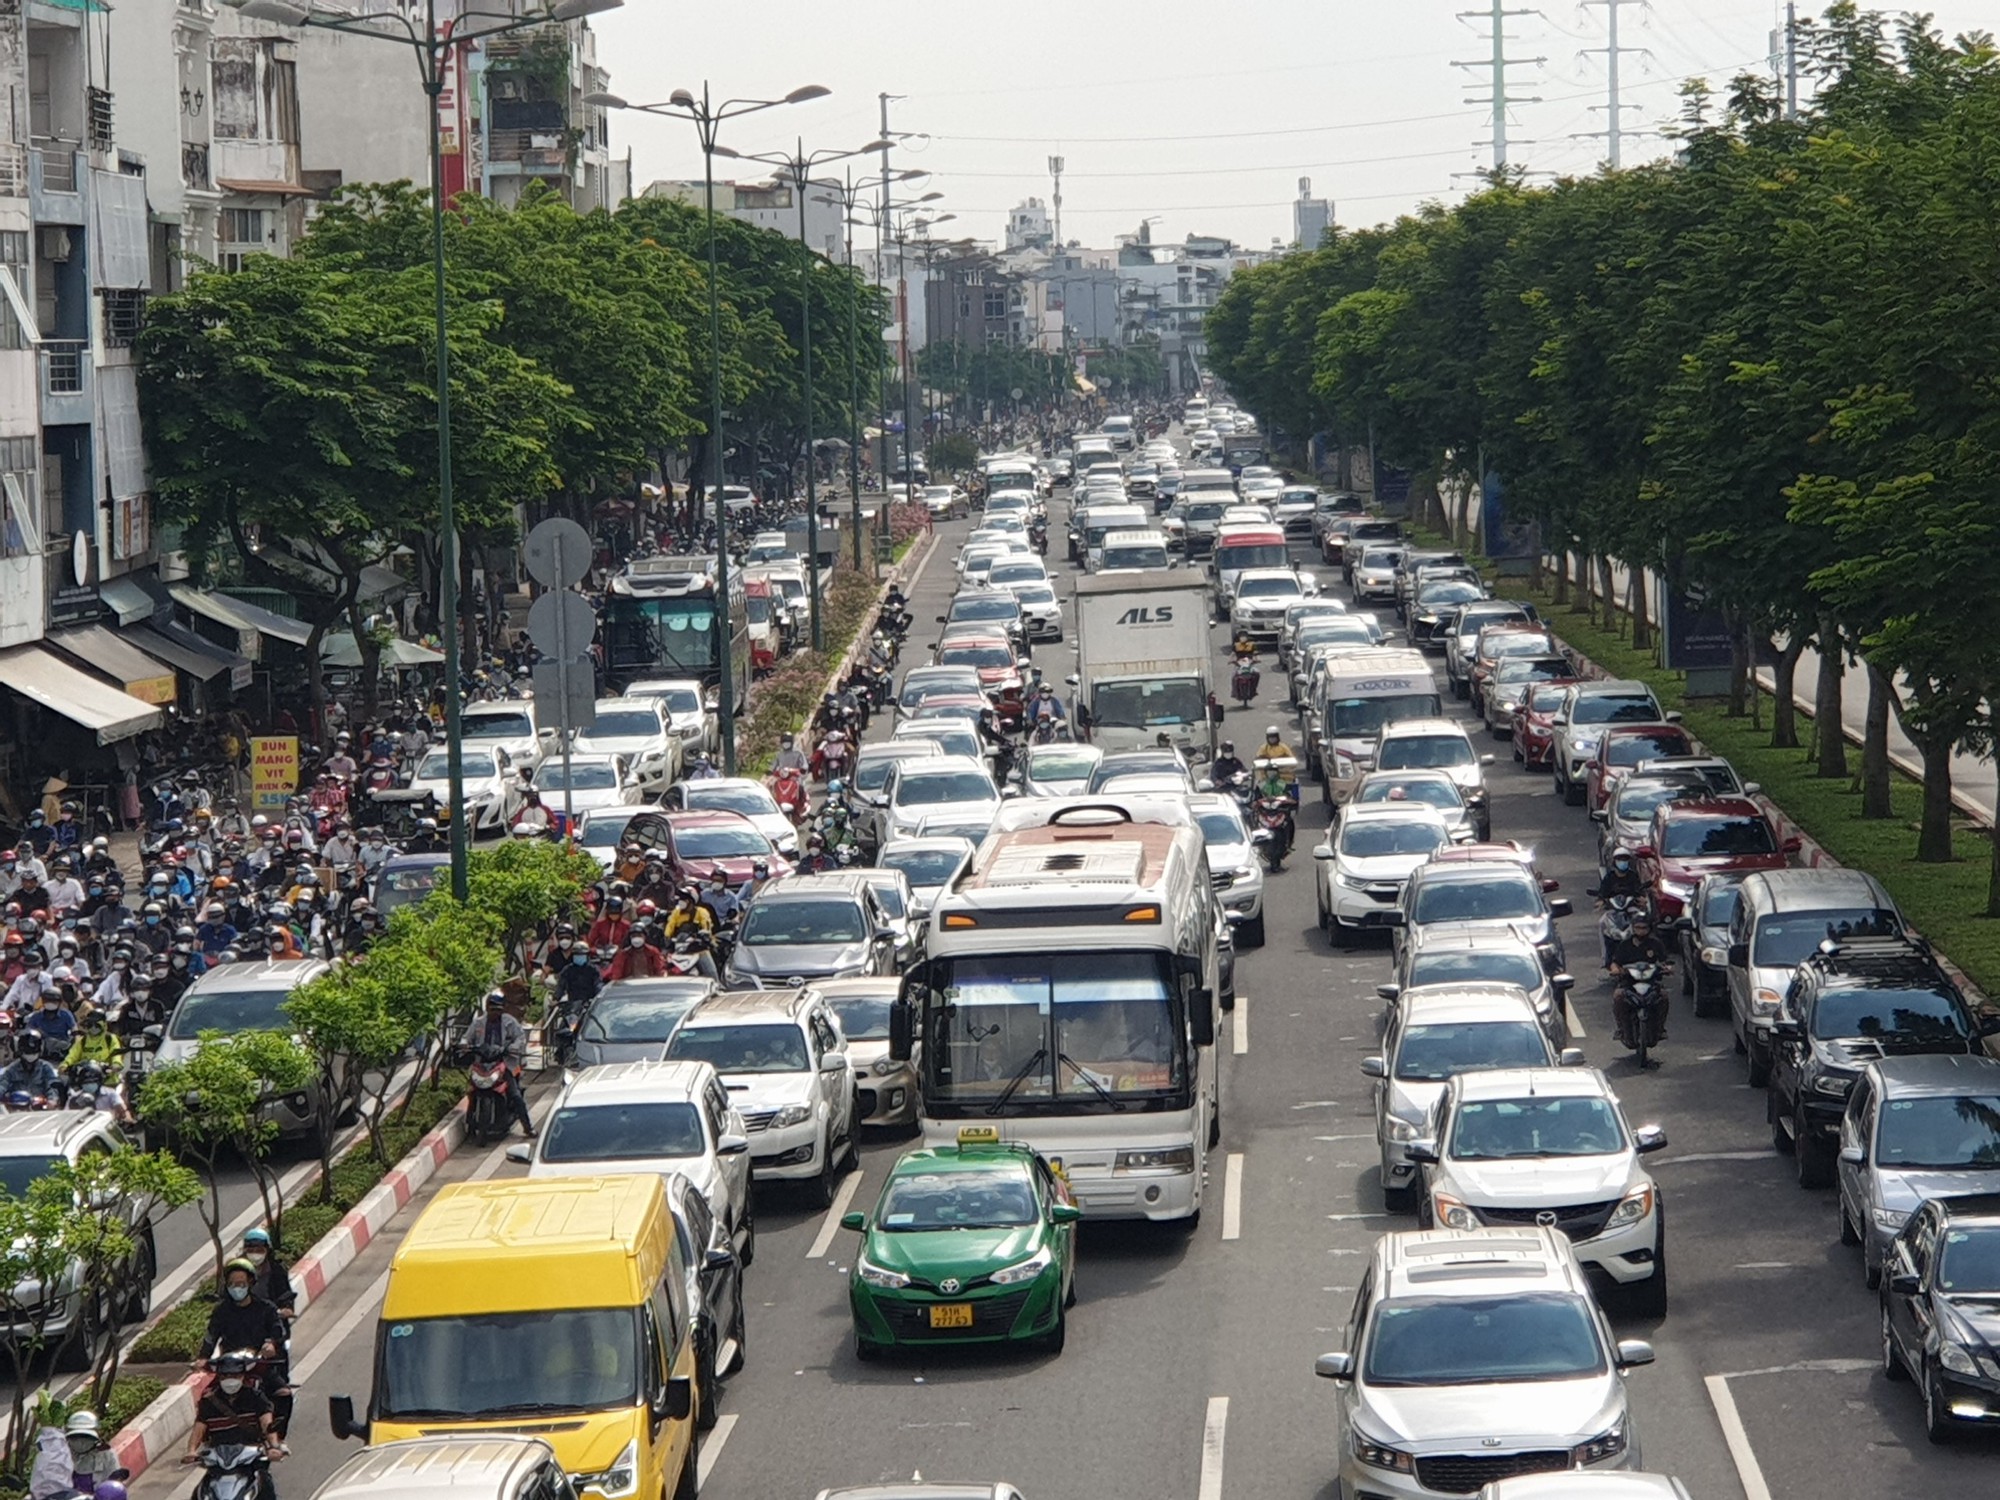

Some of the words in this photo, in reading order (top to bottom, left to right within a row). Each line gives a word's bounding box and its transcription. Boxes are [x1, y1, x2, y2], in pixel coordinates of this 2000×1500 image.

[1116, 606, 1173, 625] ALS
[256, 755, 294, 764] MANG
[265, 769, 284, 778] VIT
